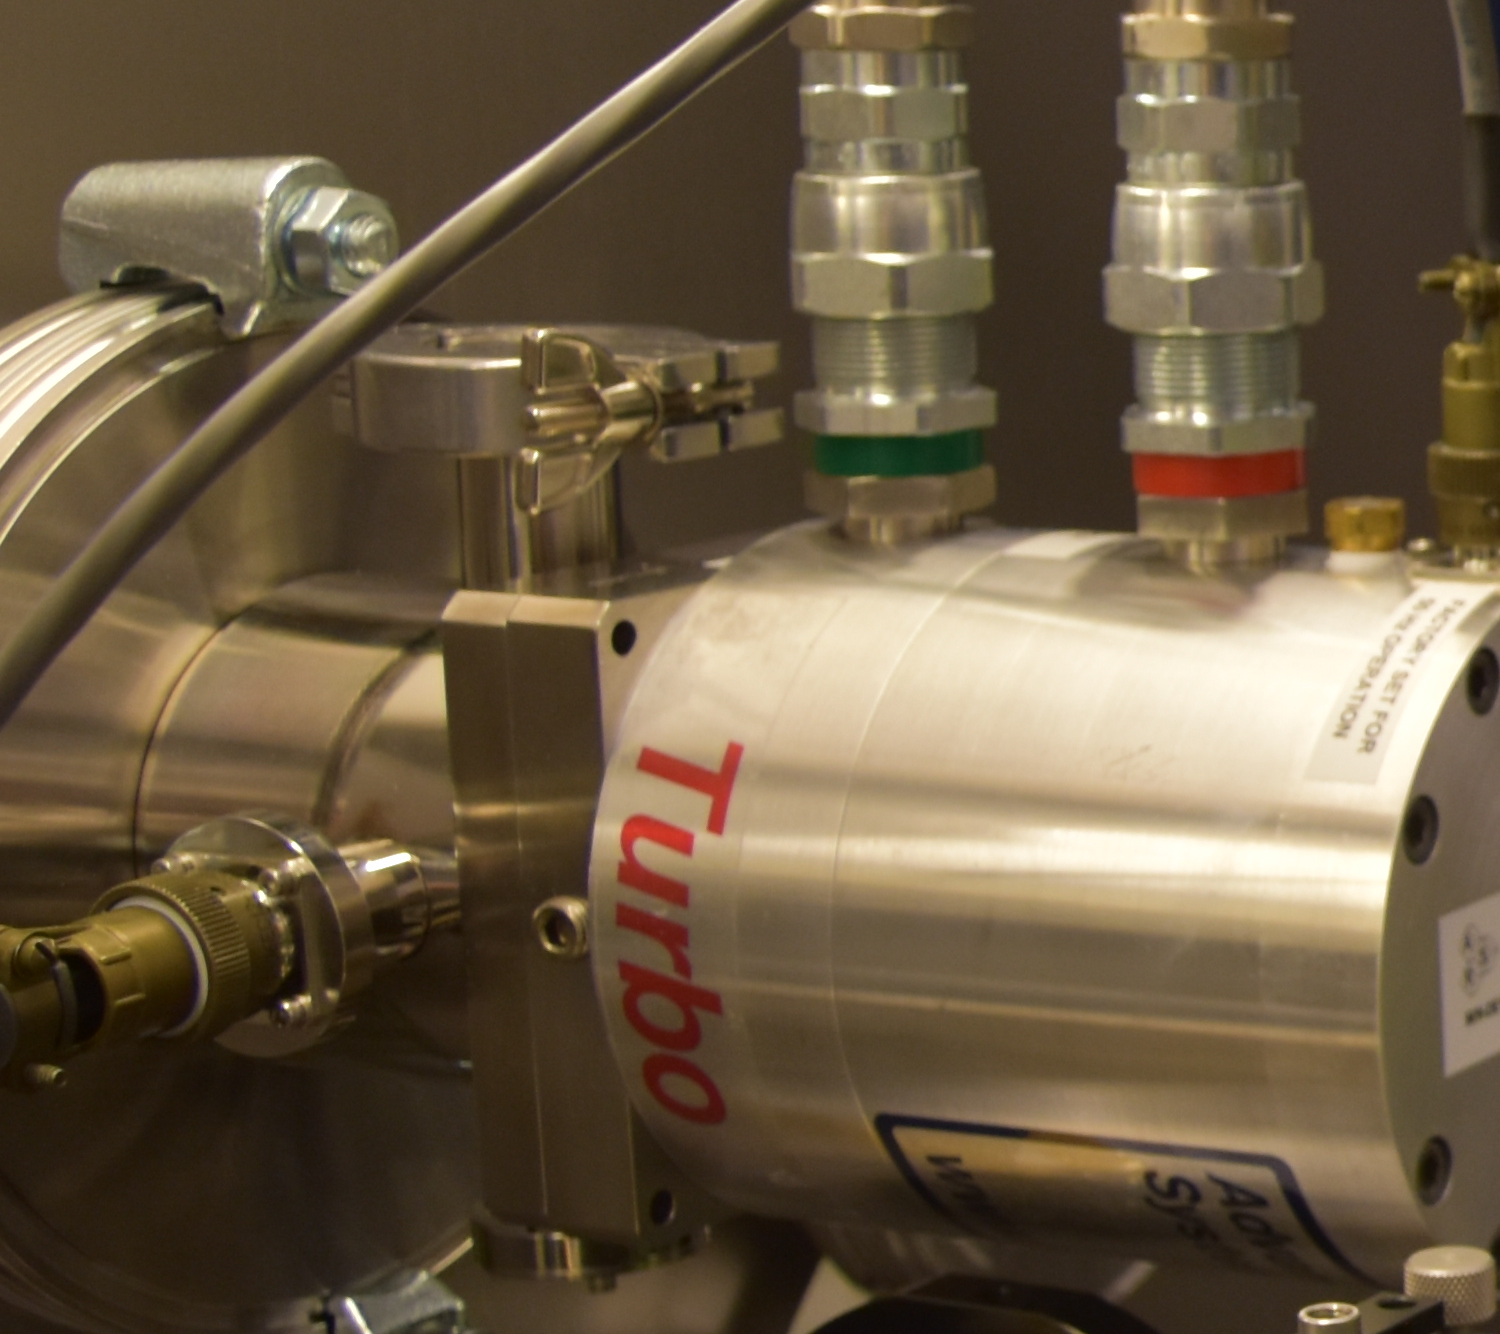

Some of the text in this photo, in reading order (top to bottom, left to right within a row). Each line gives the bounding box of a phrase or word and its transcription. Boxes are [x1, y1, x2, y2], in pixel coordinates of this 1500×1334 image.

[1333, 633, 1401, 739] OPERATION
[1380, 670, 1409, 707] SET
[1357, 710, 1388, 754] FOR
[616, 740, 745, 1126] Turbo
